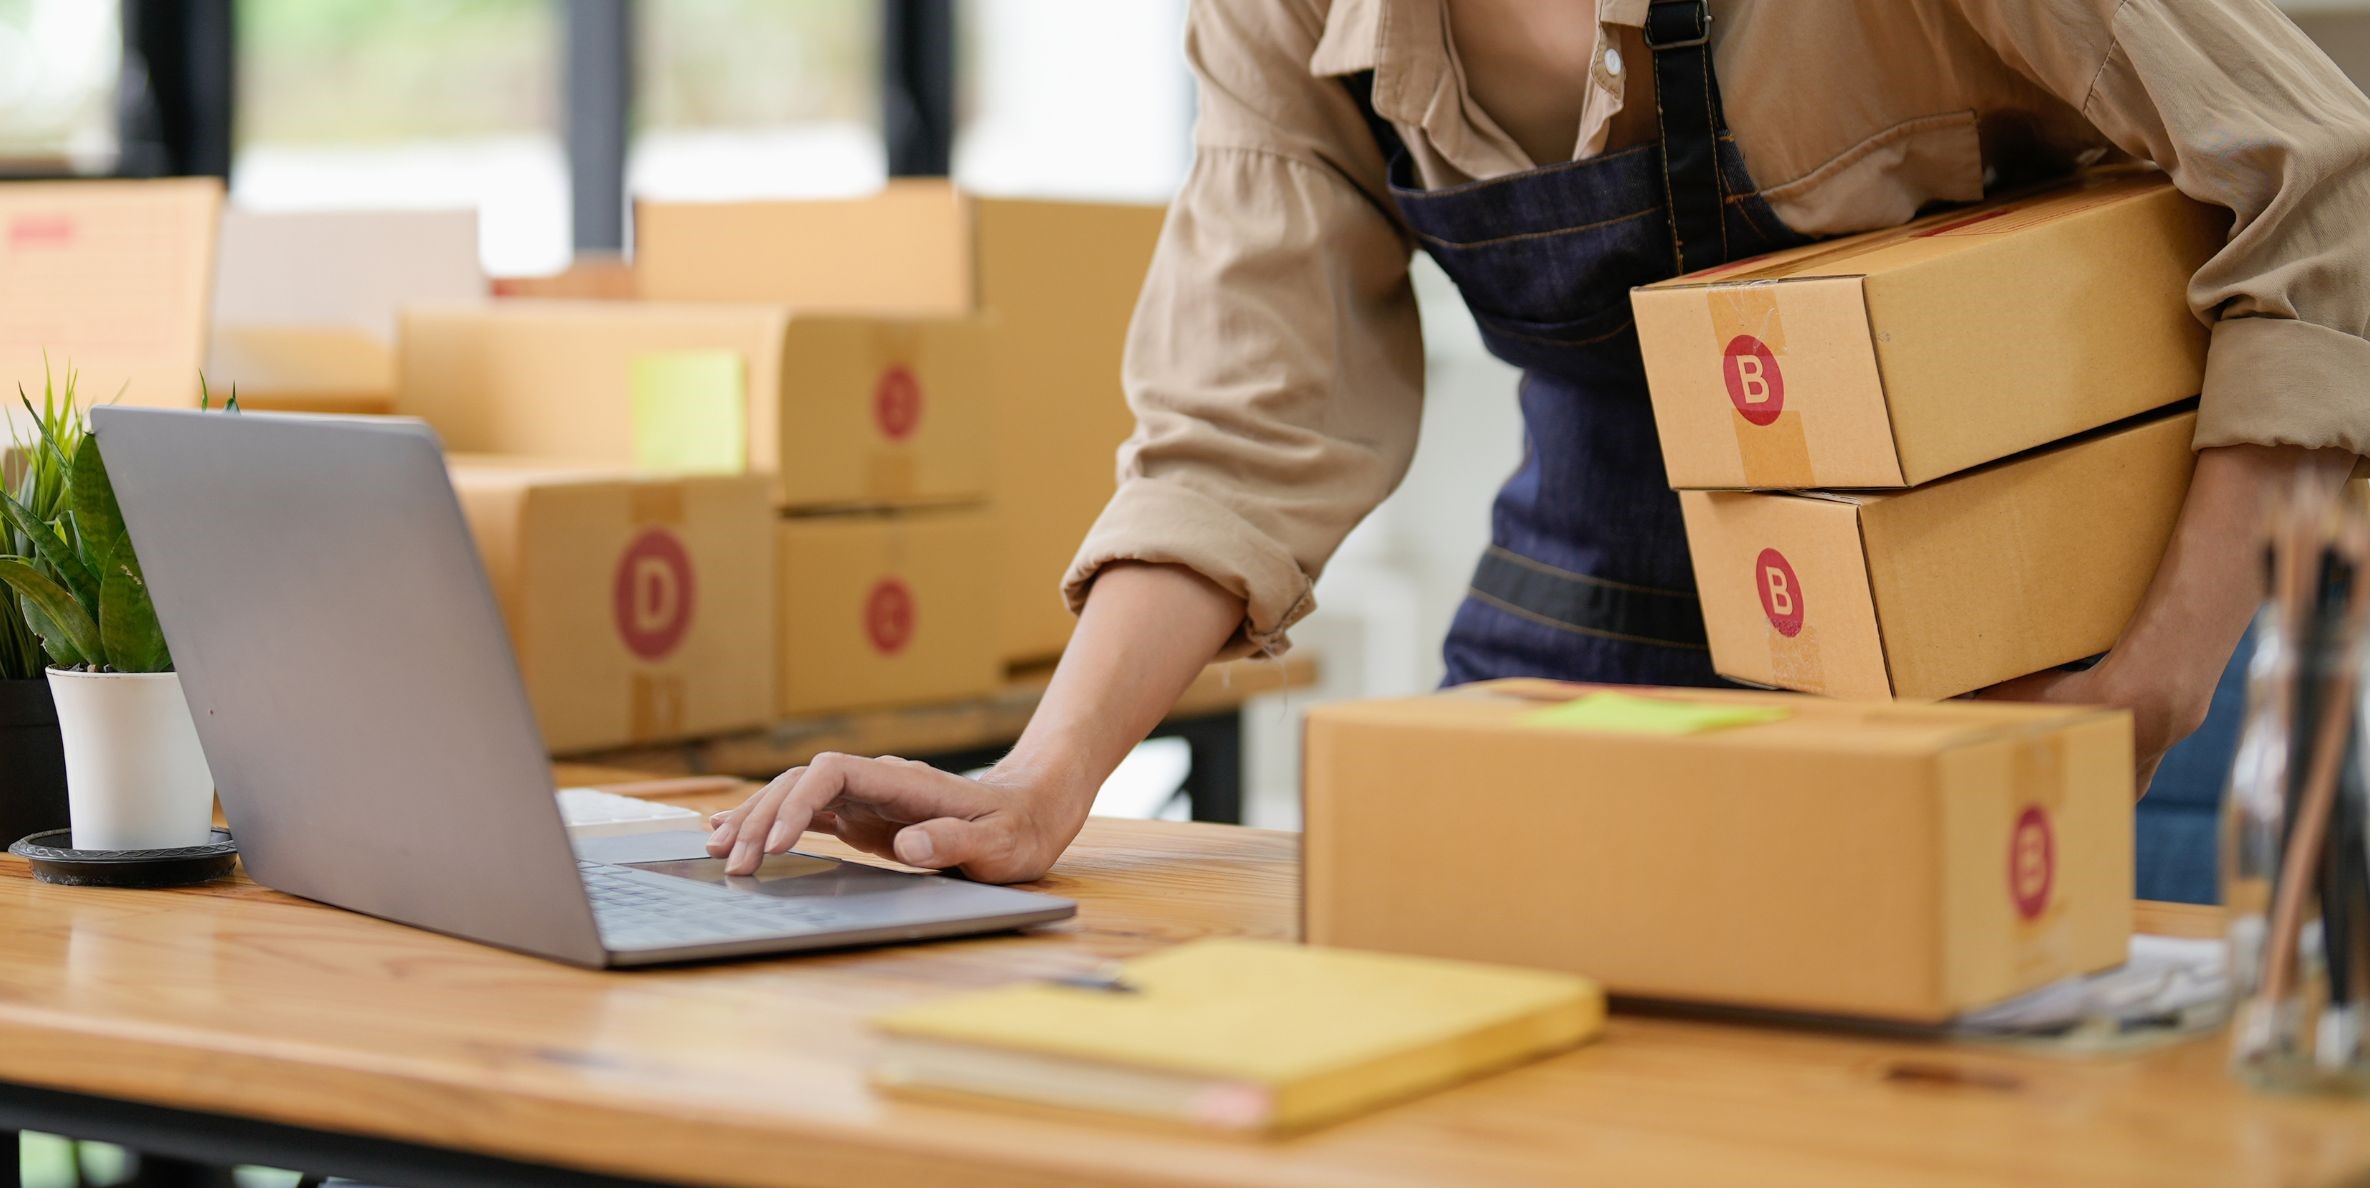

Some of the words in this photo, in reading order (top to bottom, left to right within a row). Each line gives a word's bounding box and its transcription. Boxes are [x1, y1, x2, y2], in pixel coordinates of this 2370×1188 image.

[1735, 354, 1770, 404] B
[634, 556, 679, 632] D
[1765, 566, 1793, 616] B
